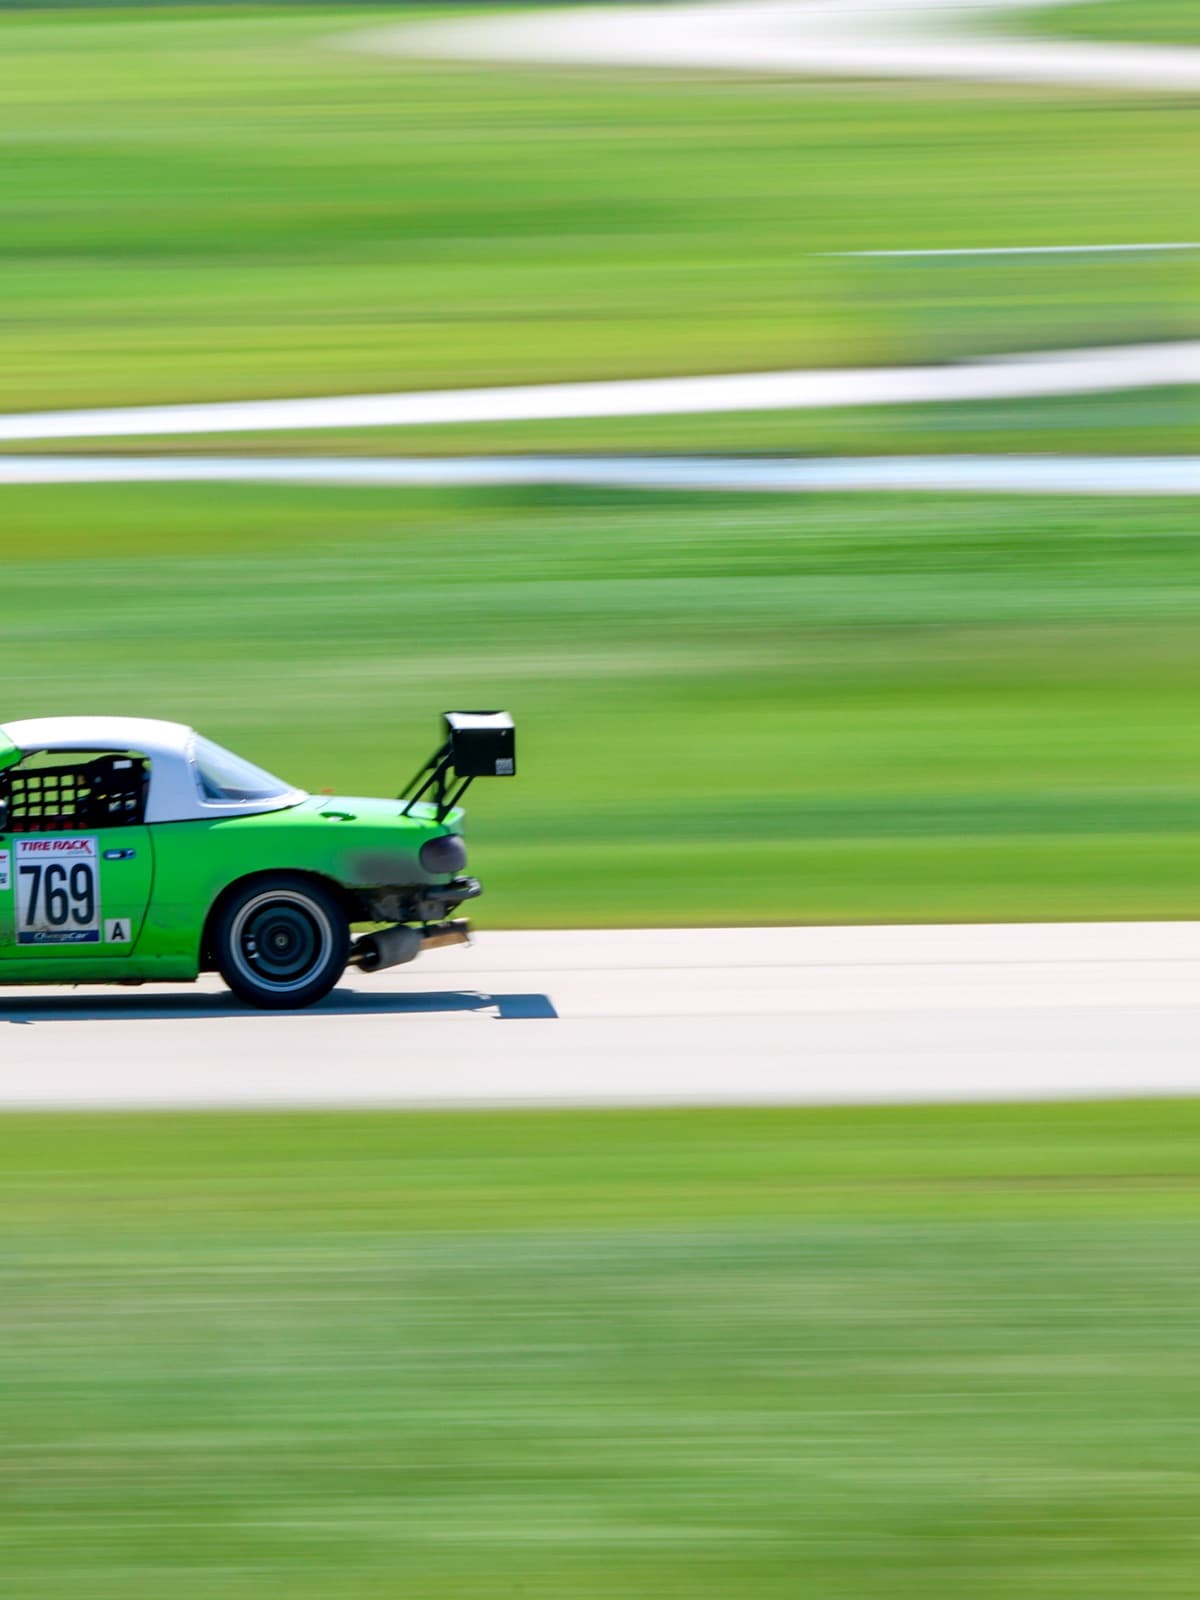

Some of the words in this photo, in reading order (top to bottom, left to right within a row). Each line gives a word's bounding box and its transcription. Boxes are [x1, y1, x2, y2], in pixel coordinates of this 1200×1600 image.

[20, 841, 51, 851] TIRE
[53, 840, 91, 852] RACK
[19, 863, 94, 926] 769
[111, 922, 125, 940] A
